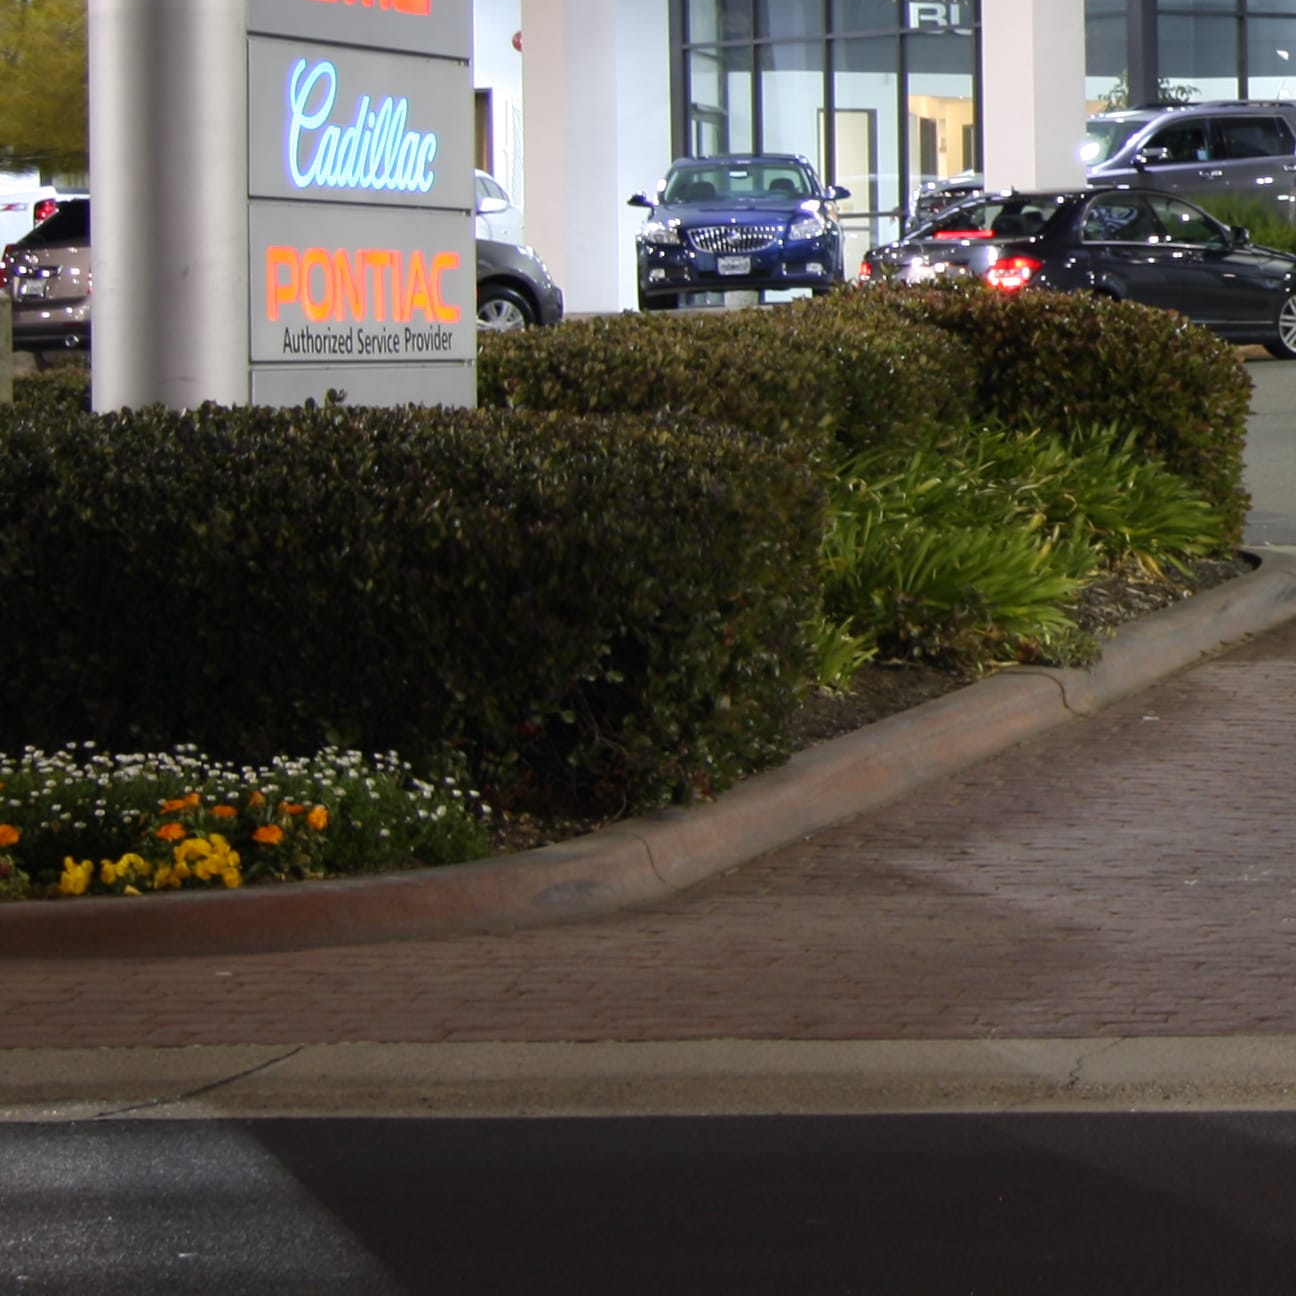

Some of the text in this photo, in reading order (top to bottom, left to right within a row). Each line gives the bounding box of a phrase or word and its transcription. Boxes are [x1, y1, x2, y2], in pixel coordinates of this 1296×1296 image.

[288, 58, 438, 193] Cadillac
[266, 245, 461, 323] PONTIAC
[283, 324, 453, 354] Authorized Service Provider
